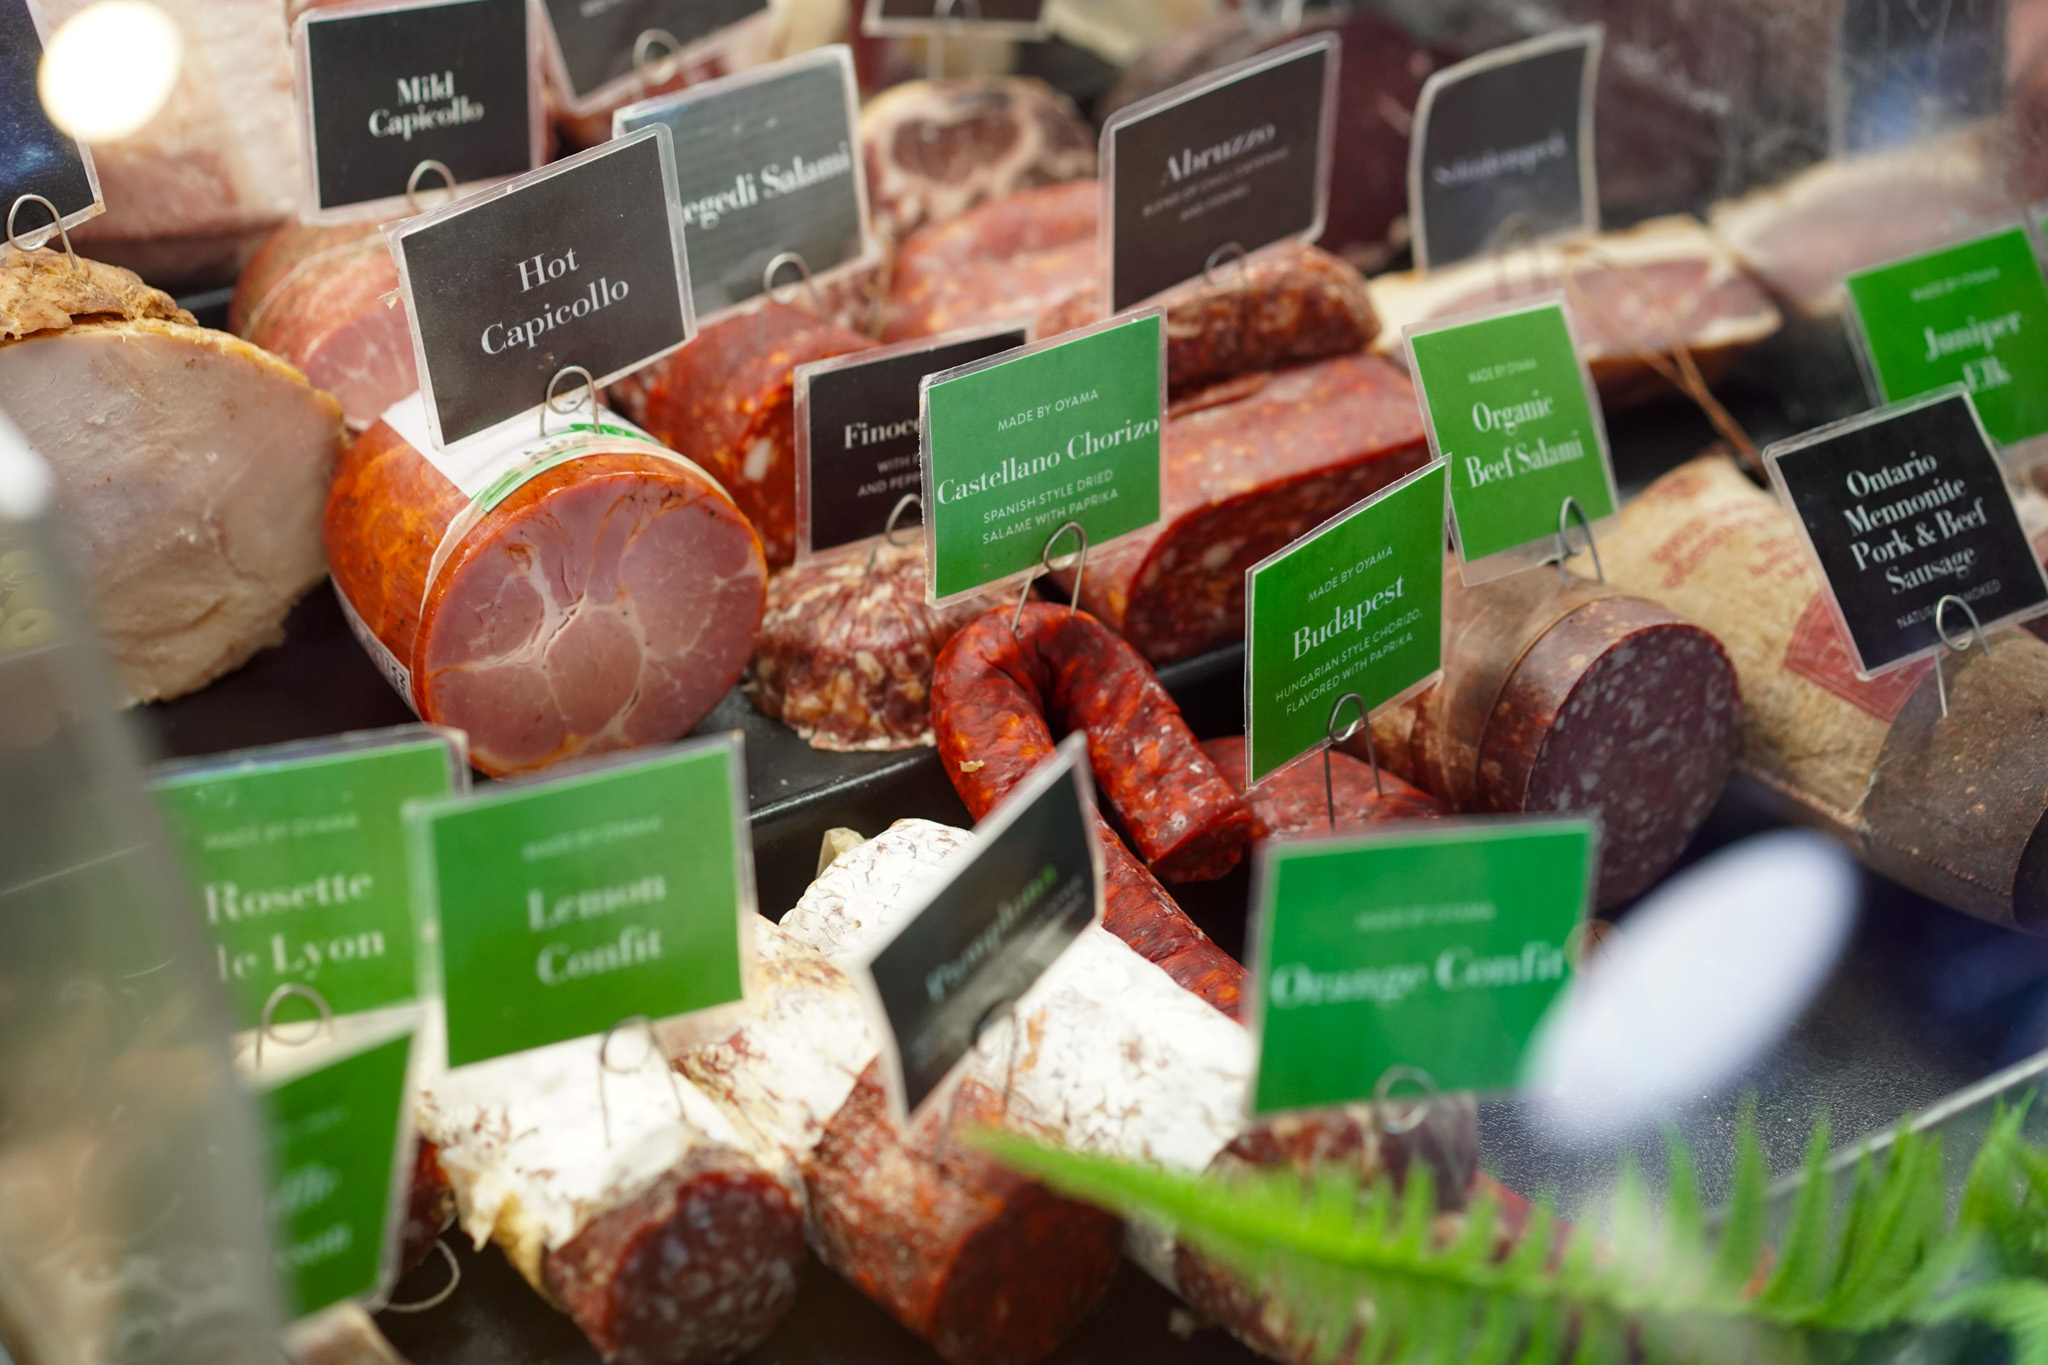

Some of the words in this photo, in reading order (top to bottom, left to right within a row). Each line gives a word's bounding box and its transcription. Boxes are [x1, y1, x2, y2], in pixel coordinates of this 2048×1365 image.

[397, 70, 454, 106] Mild
[368, 94, 485, 142] Capicollo
[682, 173, 758, 230] egedi
[761, 140, 850, 199] Salami
[515, 247, 580, 293] Hot
[481, 276, 629, 355] Capicollo
[1923, 310, 2021, 363] Juniper
[997, 410, 1033, 432] MADE
[1037, 404, 1051, 419] BY
[1055, 389, 1099, 412] OYAMA
[1472, 389, 1553, 436] Organic
[937, 451, 1061, 505] Castellano
[1066, 418, 1159, 460] Chorizo
[1465, 446, 1513, 488] Beef
[1515, 429, 1584, 474] Salami
[1846, 450, 1938, 498] Ontario
[857, 479, 888, 497] AND
[983, 498, 1036, 524] SPANISH
[1038, 483, 1073, 506] STYLE
[1076, 468, 1114, 492] DRIED
[1842, 477, 1968, 538] Mennonite
[982, 518, 1032, 545] SALAME
[1035, 506, 1066, 526] WITH
[1068, 488, 1119, 516] PAPRIKA
[1849, 528, 1915, 571] Pork
[1914, 521, 1938, 548] &
[1934, 496, 1987, 540] Beef
[1308, 576, 1338, 603] MADE
[1341, 567, 1353, 584] BY
[1355, 546, 1393, 574] OYAMA
[1885, 547, 1978, 595] Sausage
[1292, 575, 1405, 662] Budapest
[1275, 655, 1339, 703] HUNGARIAN
[1341, 636, 1370, 663] STYLE
[1286, 674, 1340, 716] FLAVORED
[1342, 656, 1368, 682] WITH
[1369, 631, 1413, 665] PAPRIKA
[205, 872, 374, 925] Rosette
[527, 874, 666, 932] Lemon
[271, 930, 385, 981] Lyon
[535, 925, 662, 987] Confit
[1435, 939, 1564, 991] Confit
